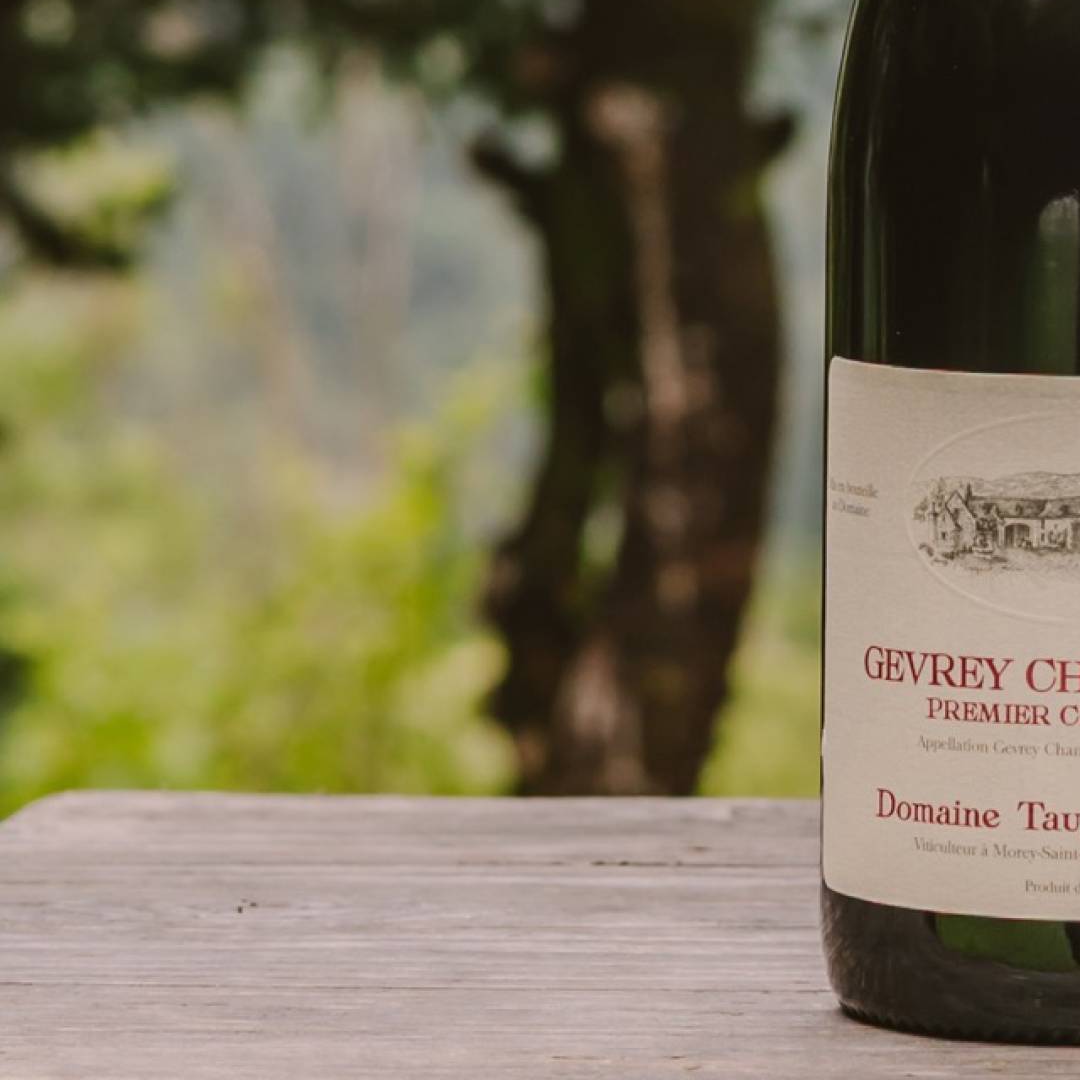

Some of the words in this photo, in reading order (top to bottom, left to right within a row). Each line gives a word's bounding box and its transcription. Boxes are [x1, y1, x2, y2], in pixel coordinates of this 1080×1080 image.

[864, 645, 1014, 691] GEVREY
[927, 697, 1051, 726] PREMIER
[918, 735, 989, 754] Appellation
[994, 741, 1038, 758] Gevrey
[876, 788, 1000, 829] Domaine
[914, 837, 977, 856] Viticulteur
[981, 843, 988, 856] à
[1025, 880, 1070, 894] Produit
